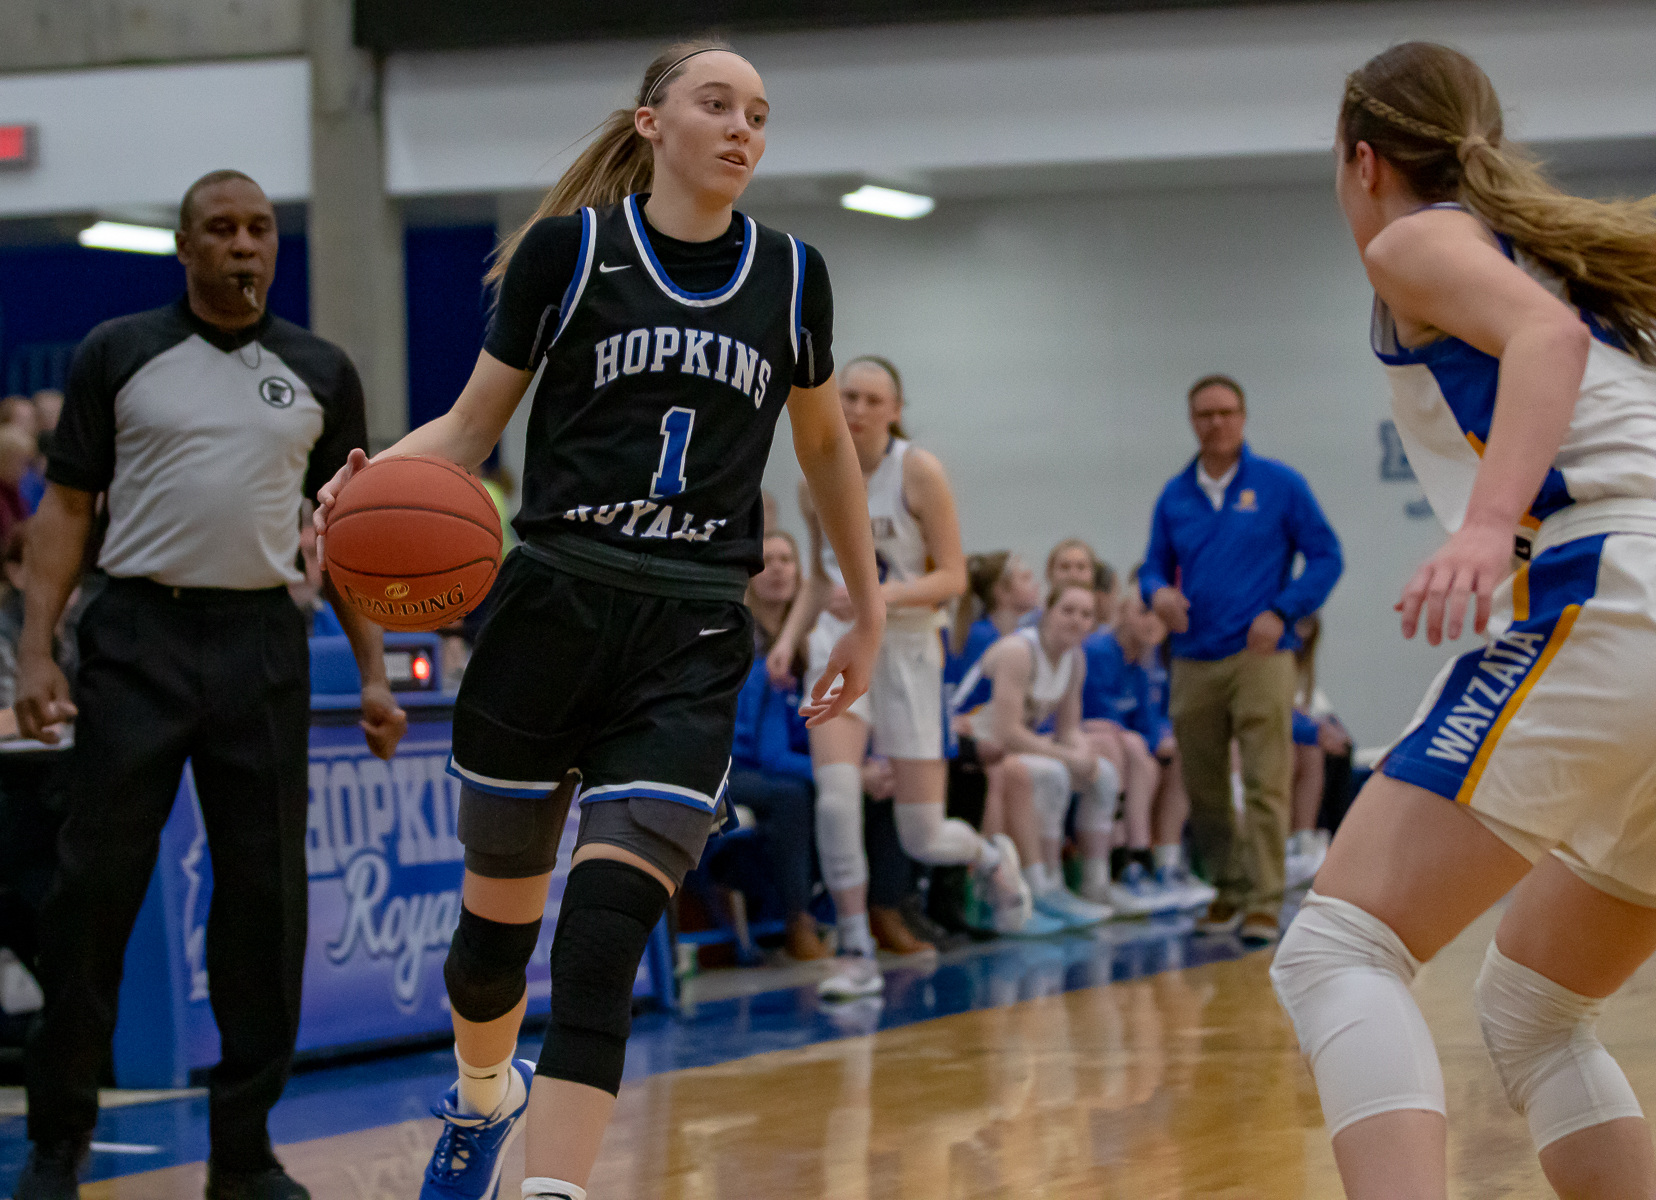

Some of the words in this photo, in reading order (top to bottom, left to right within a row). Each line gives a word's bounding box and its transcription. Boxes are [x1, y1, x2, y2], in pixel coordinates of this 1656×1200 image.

[594, 327, 772, 409] HOPKINS
[650, 406, 696, 499] 1
[344, 582, 465, 616] SPALDING
[1427, 630, 1544, 765] WAYZATA
[307, 758, 464, 874] HOPKI
